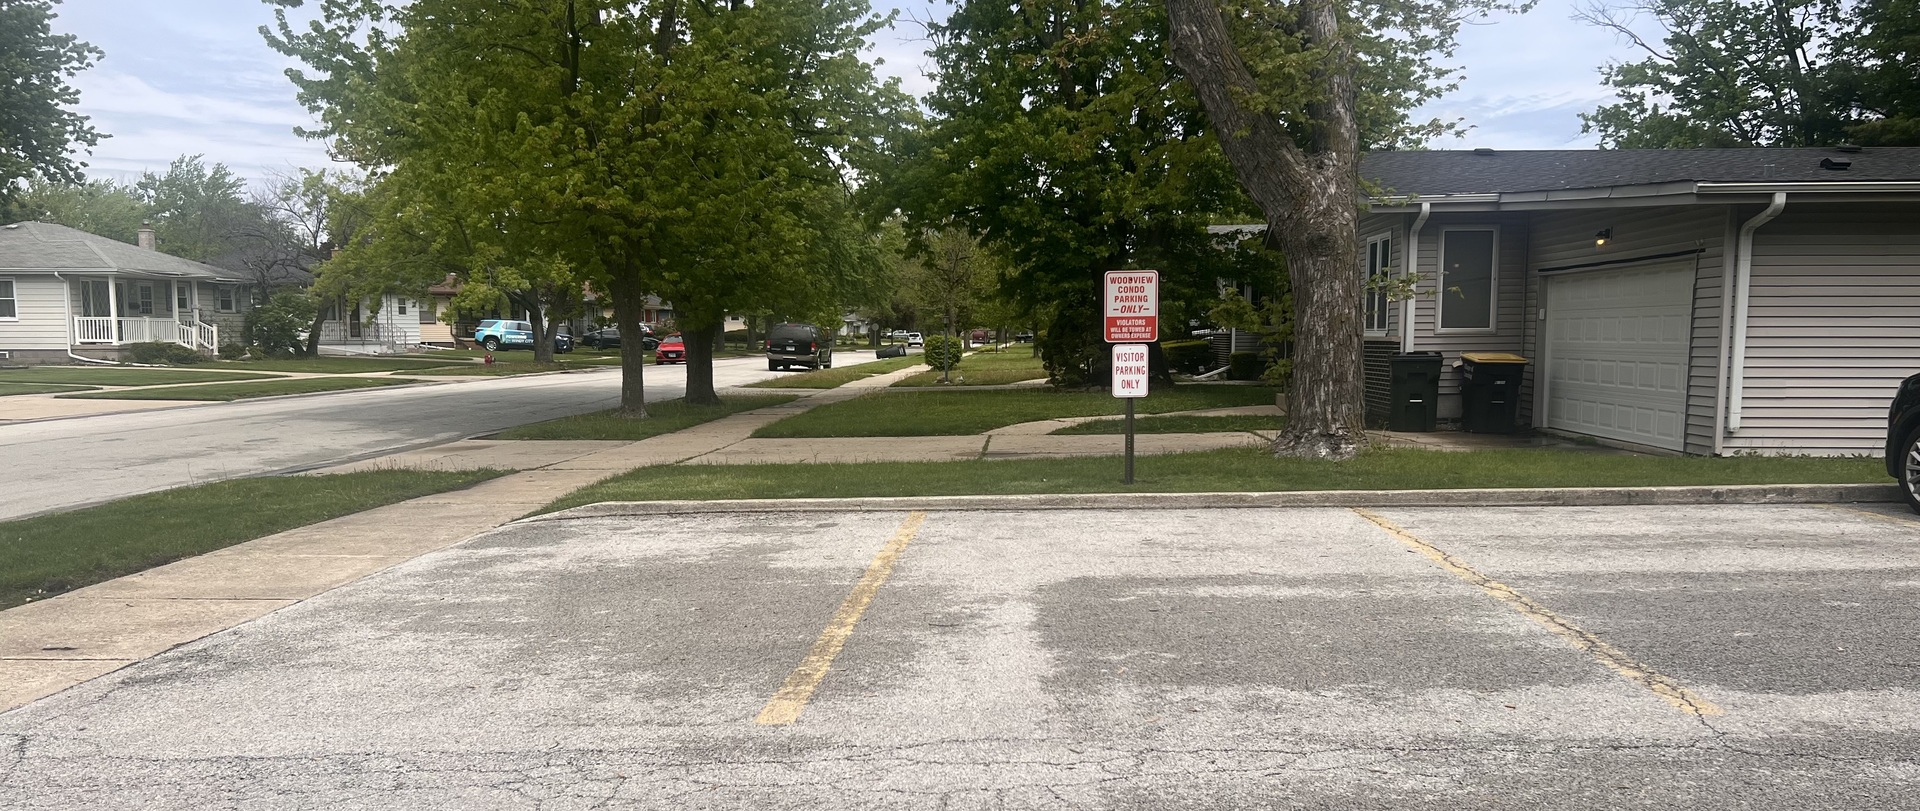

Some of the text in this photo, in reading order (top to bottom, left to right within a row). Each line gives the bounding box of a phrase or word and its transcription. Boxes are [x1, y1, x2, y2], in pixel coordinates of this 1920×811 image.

[1114, 295, 1148, 303] PARKING
[1116, 352, 1145, 362] VISITOR
[1116, 366, 1146, 375] PARKING
[1121, 379, 1140, 389] ONLY
